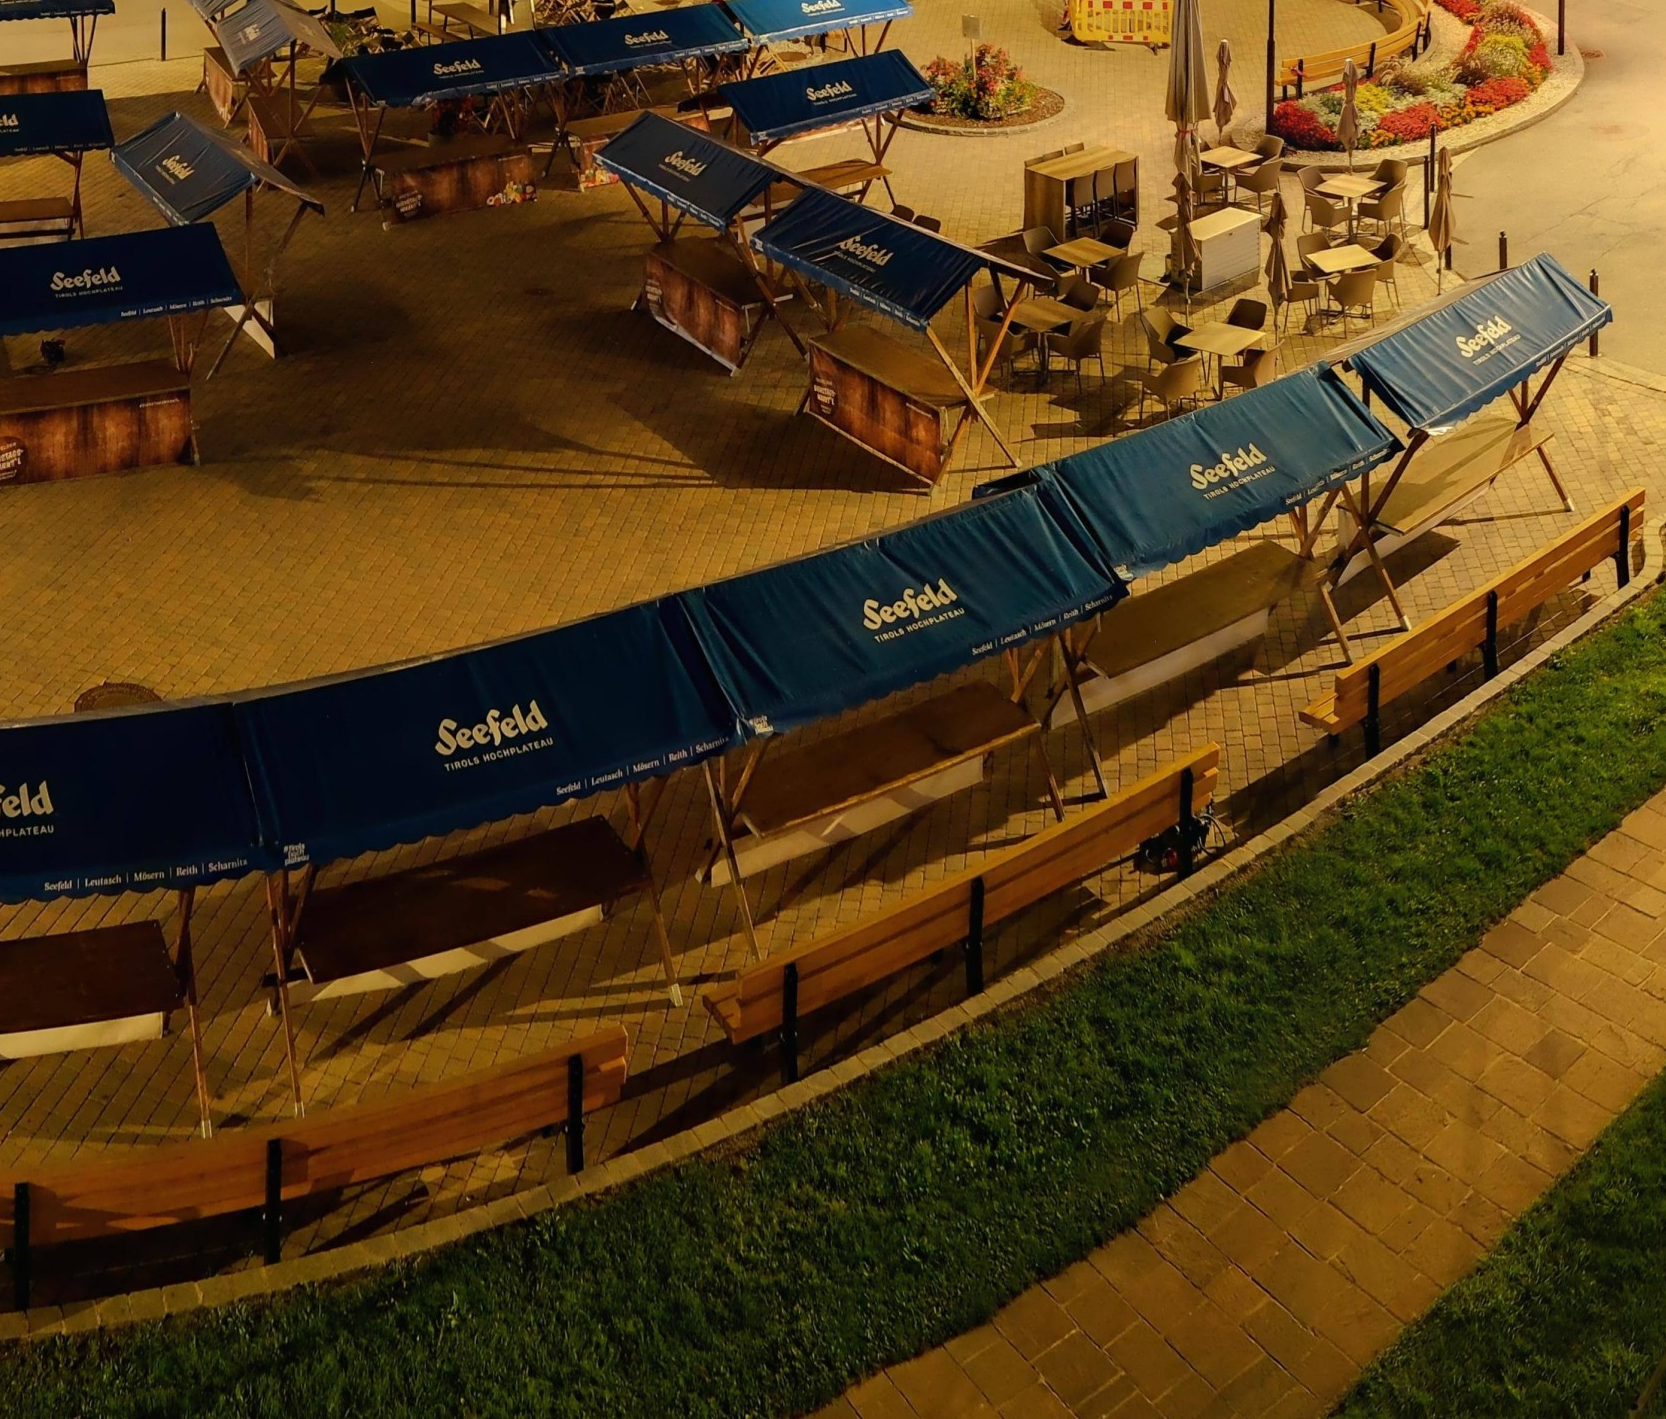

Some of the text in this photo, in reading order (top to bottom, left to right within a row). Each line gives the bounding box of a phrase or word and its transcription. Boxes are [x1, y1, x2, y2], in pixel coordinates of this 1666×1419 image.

[624, 30, 669, 46] Seefeld
[433, 58, 481, 75] Seefeld
[806, 80, 853, 101] Seefeld
[664, 151, 708, 176] Seefeld
[839, 236, 894, 266] Seefeld
[49, 265, 121, 291] Seefeld
[1455, 315, 1512, 358] Seefeld
[1189, 442, 1268, 490] Seefeld
[1203, 466, 1276, 501] TIROLS HOCHPLATEAU
[862, 576, 958, 631] Seefeld
[874, 607, 966, 644] TIROLS HOCHPLATEAU
[972, 641, 993, 656] Seefeld
[1000, 629, 1027, 645] Leutasch
[434, 698, 549, 757] Seefeld
[444, 737, 554, 772] TIROLS HOCHPLATEAU
[556, 781, 581, 796] Seefeld
[591, 770, 623, 787] Leutasch
[632, 758, 660, 774] Mösern
[668, 749, 688, 763] Reith
[44, 880, 73, 892] Seefeld
[84, 874, 122, 887] Leutasch
[133, 870, 165, 882] Mösern
[176, 865, 198, 877] Reith
